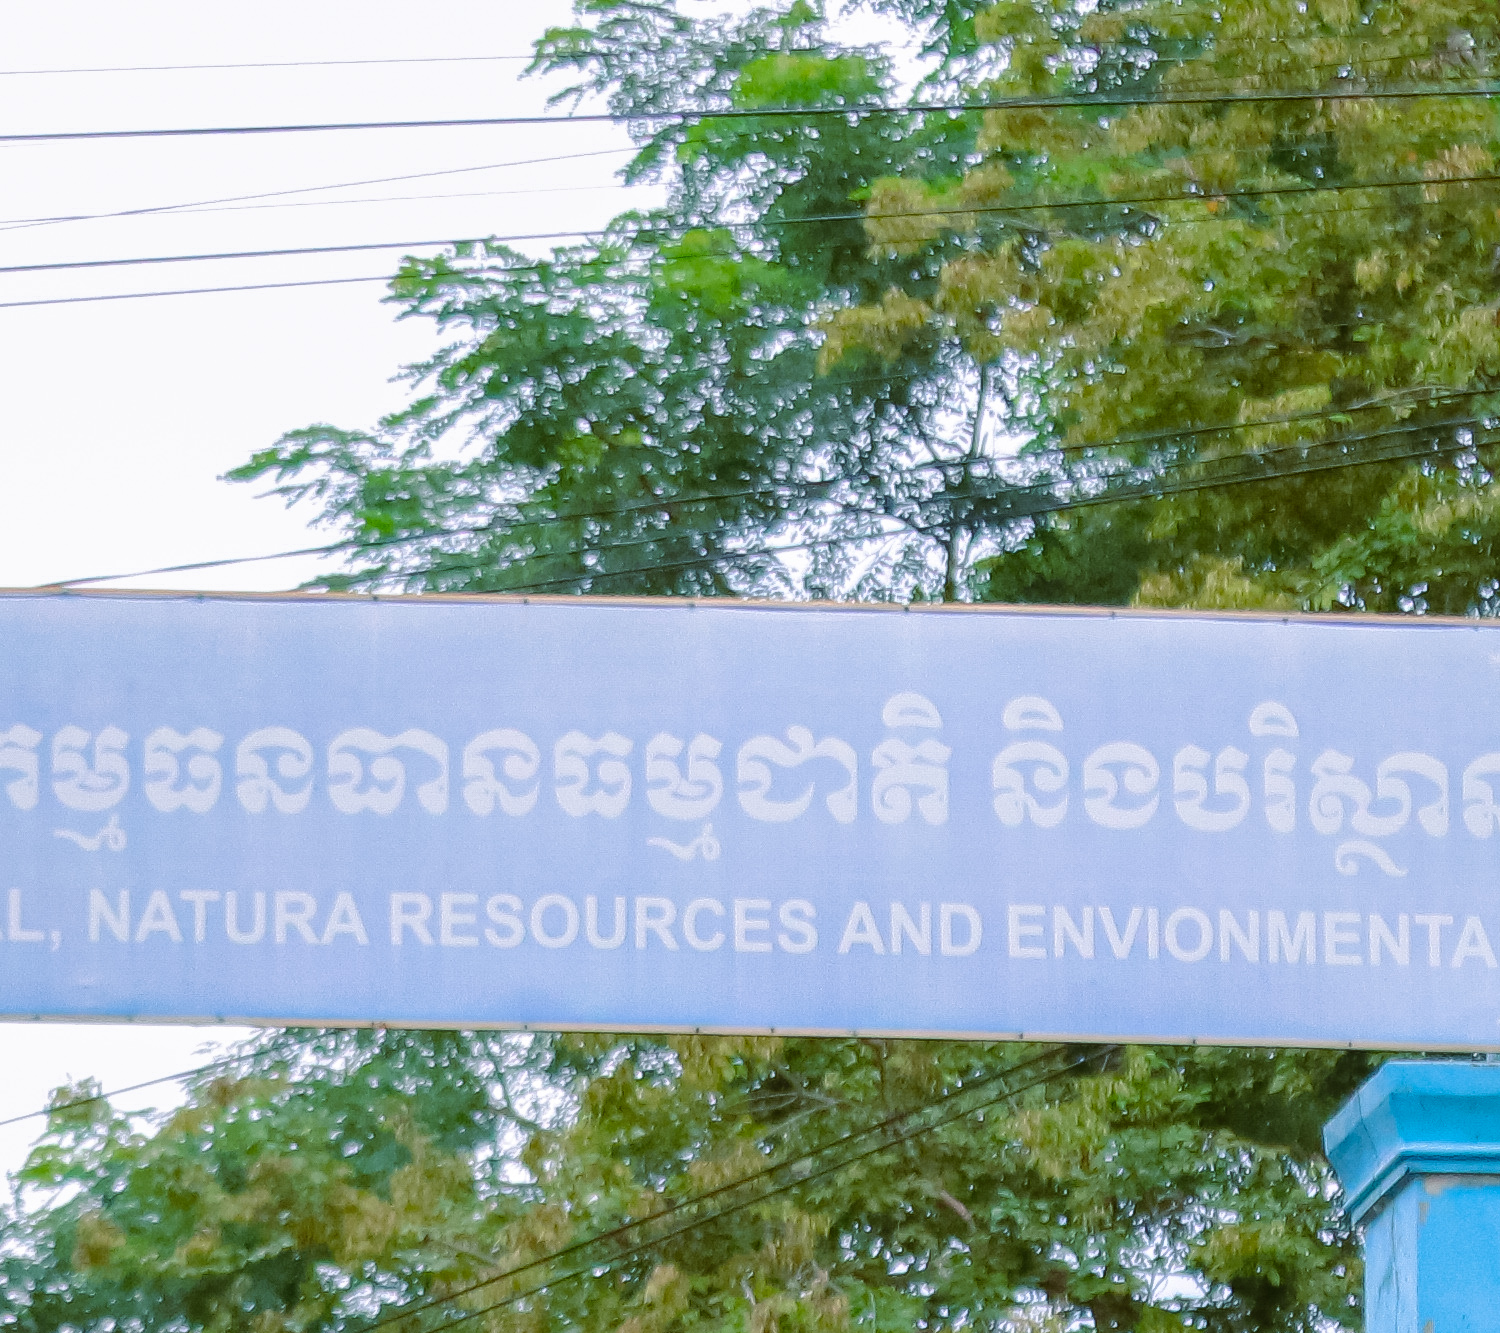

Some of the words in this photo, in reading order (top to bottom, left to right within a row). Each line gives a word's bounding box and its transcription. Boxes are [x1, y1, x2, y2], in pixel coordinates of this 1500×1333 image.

[87, 887, 369, 946] NATURA
[388, 890, 818, 954] RESOURCES
[837, 900, 983, 957] AND
